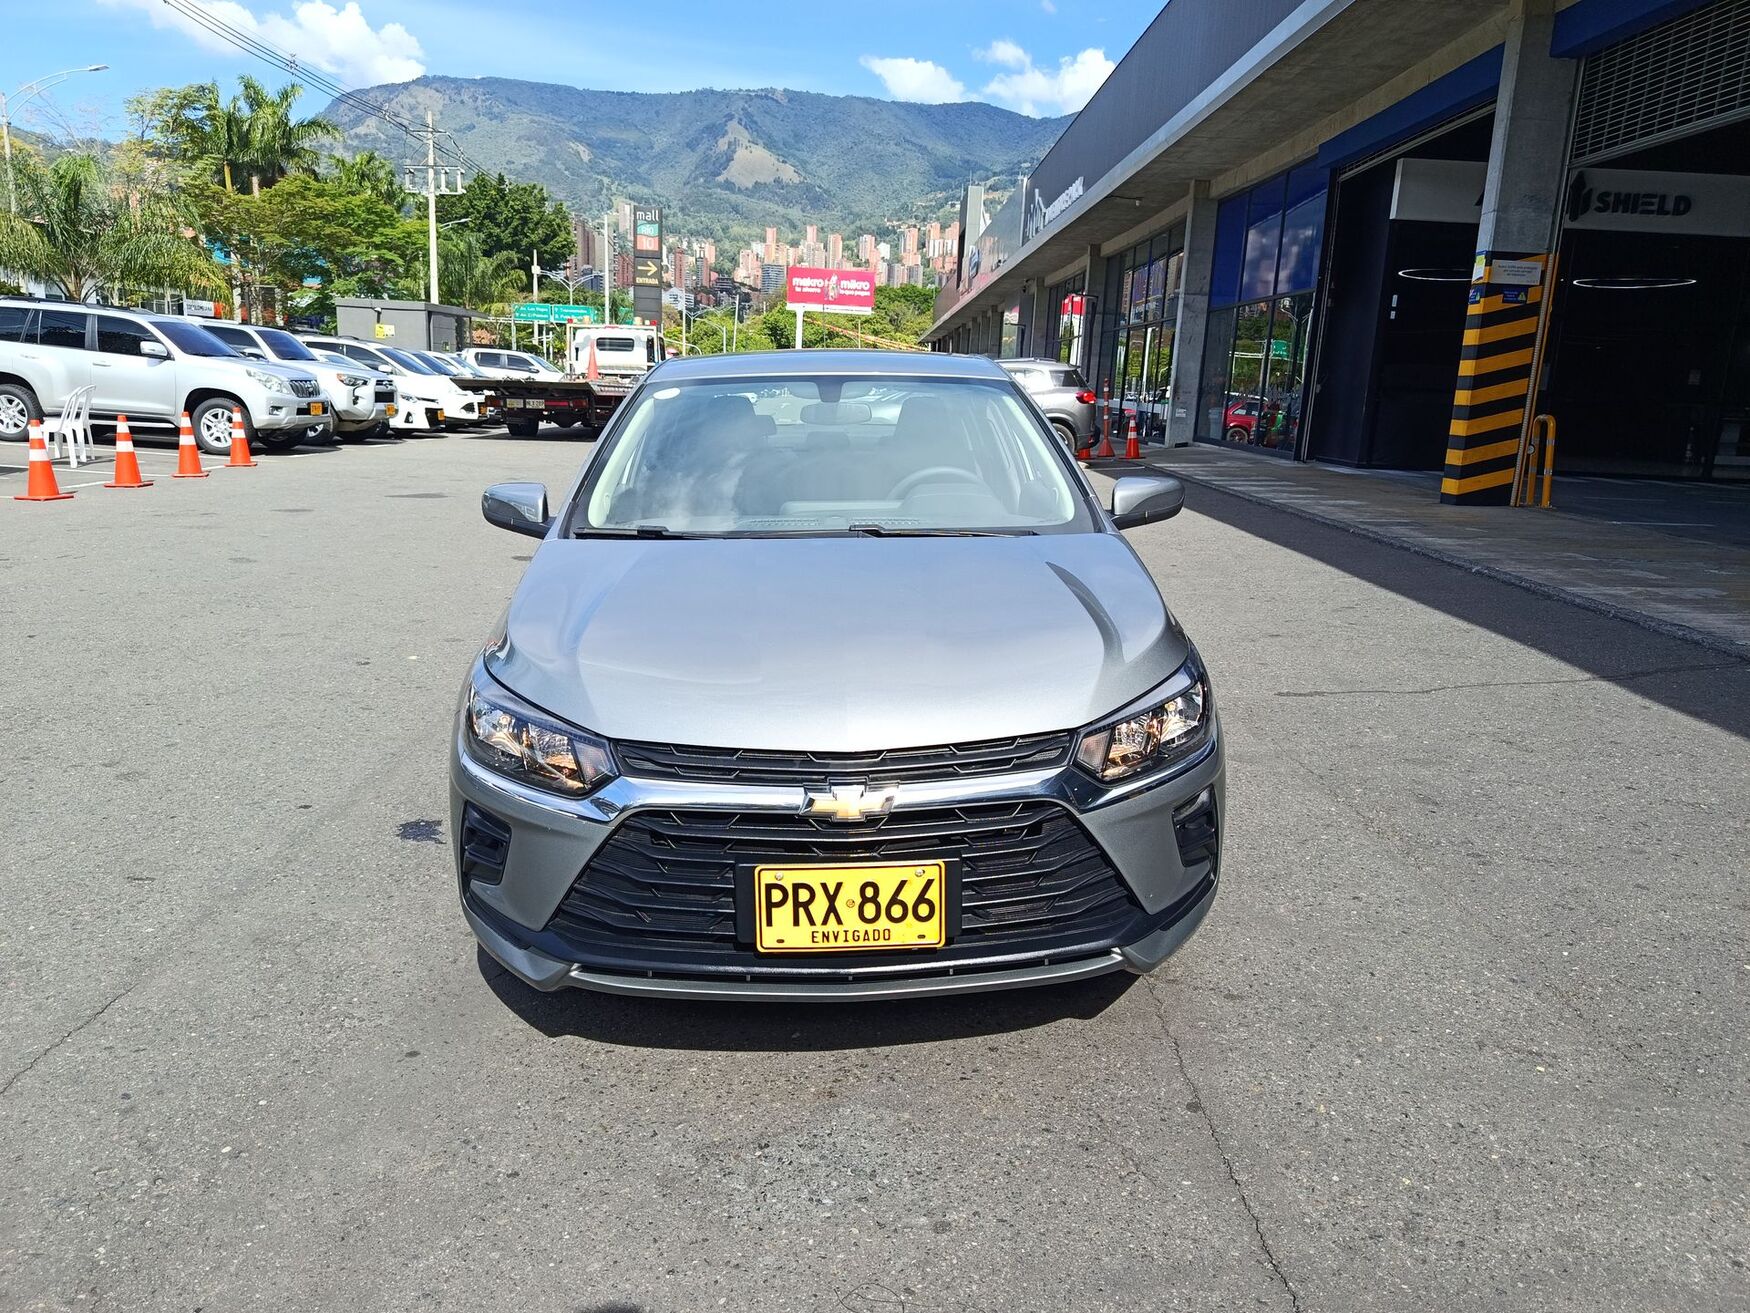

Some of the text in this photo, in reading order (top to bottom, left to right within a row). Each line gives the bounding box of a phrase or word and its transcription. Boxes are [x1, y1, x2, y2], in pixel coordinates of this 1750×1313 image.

[1594, 191, 1692, 216] SHIELD
[637, 210, 659, 221] mall
[643, 238, 655, 249] 10
[792, 277, 824, 287] makro
[841, 280, 870, 290] mikro
[765, 878, 936, 927] PRX 866
[811, 928, 891, 943] ENVIGADO
